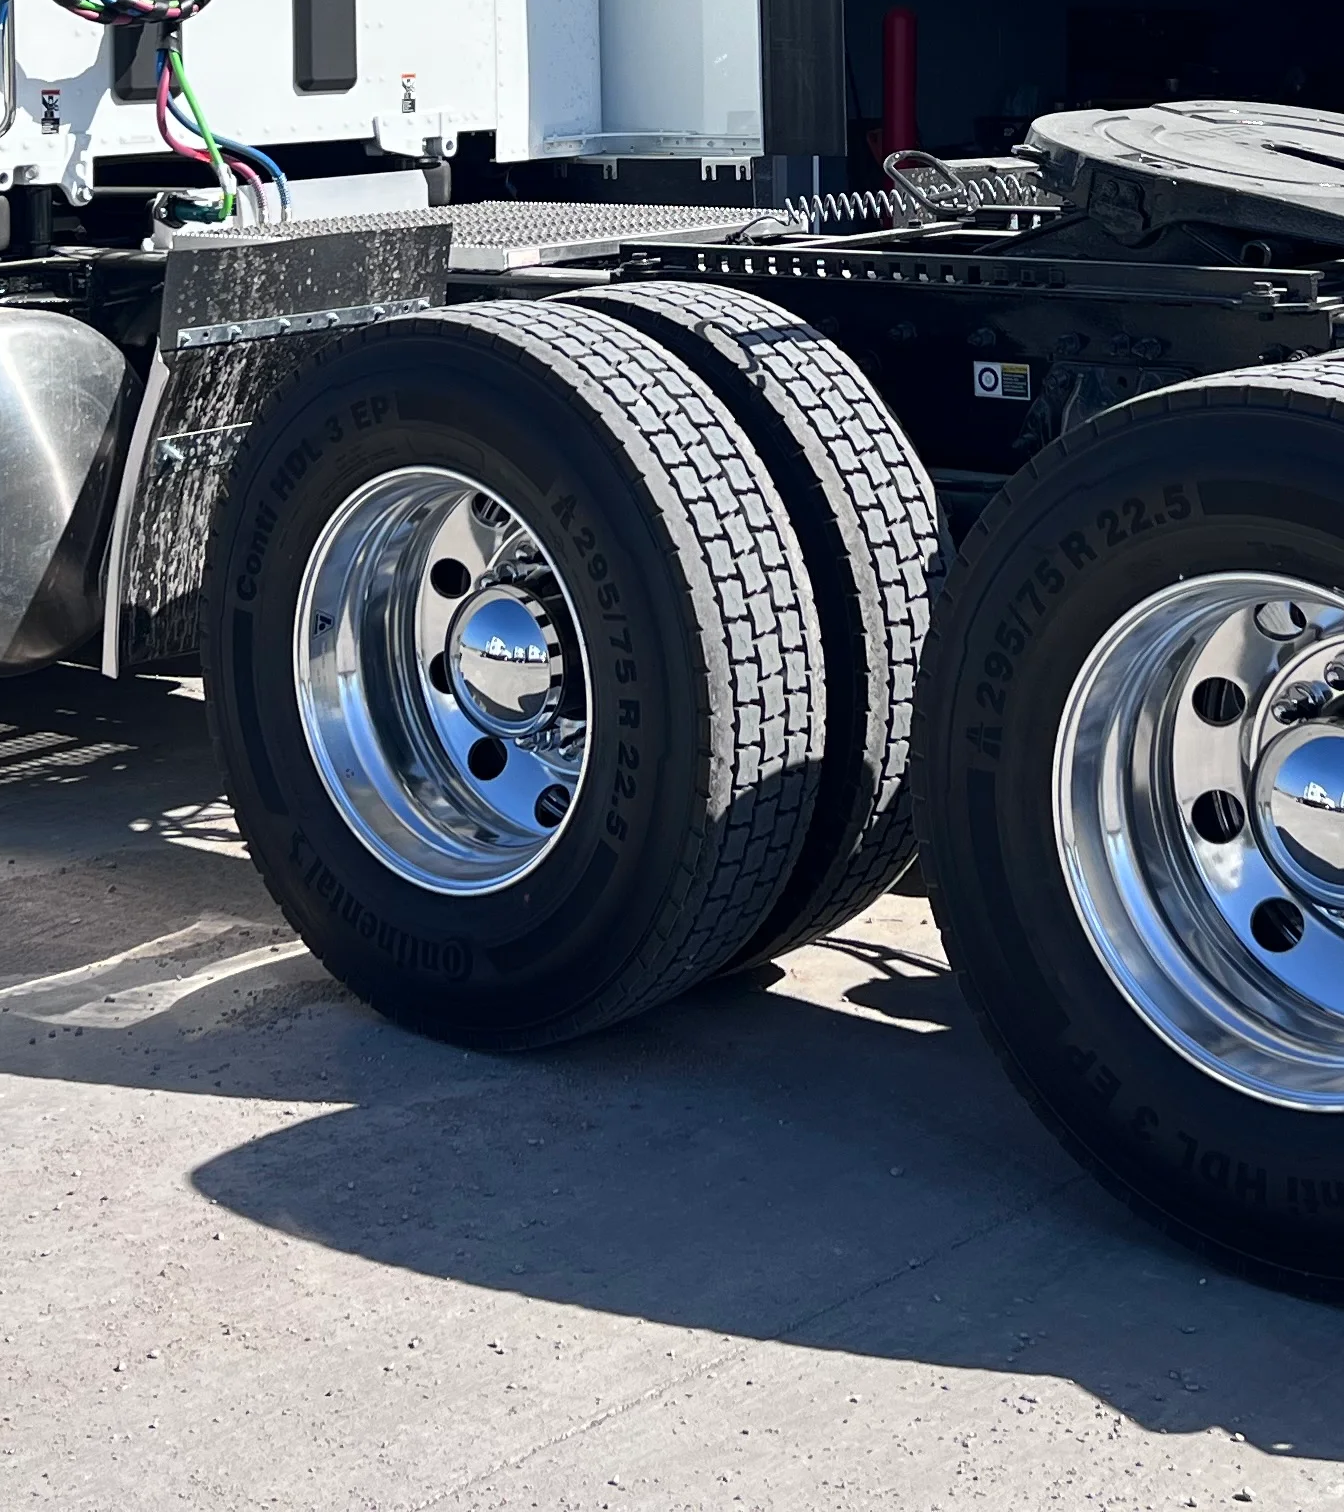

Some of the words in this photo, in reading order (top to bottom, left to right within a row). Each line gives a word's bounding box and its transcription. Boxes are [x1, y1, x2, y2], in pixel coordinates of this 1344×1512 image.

[235, 500, 279, 602] Conti
[269, 437, 324, 502] HDL
[324, 414, 345, 444] 3
[349, 394, 391, 431] EP
[572, 525, 638, 685] 295/75
[975, 558, 1066, 716] 295/75
[1058, 529, 1098, 569] R
[1096, 484, 1192, 548] 22.5
[617, 698, 641, 730] R
[605, 739, 641, 845] 22.5
[302, 855, 474, 984] Continental
[1067, 1044, 1122, 1104] EP
[1176, 1129, 1268, 1209] HDL
